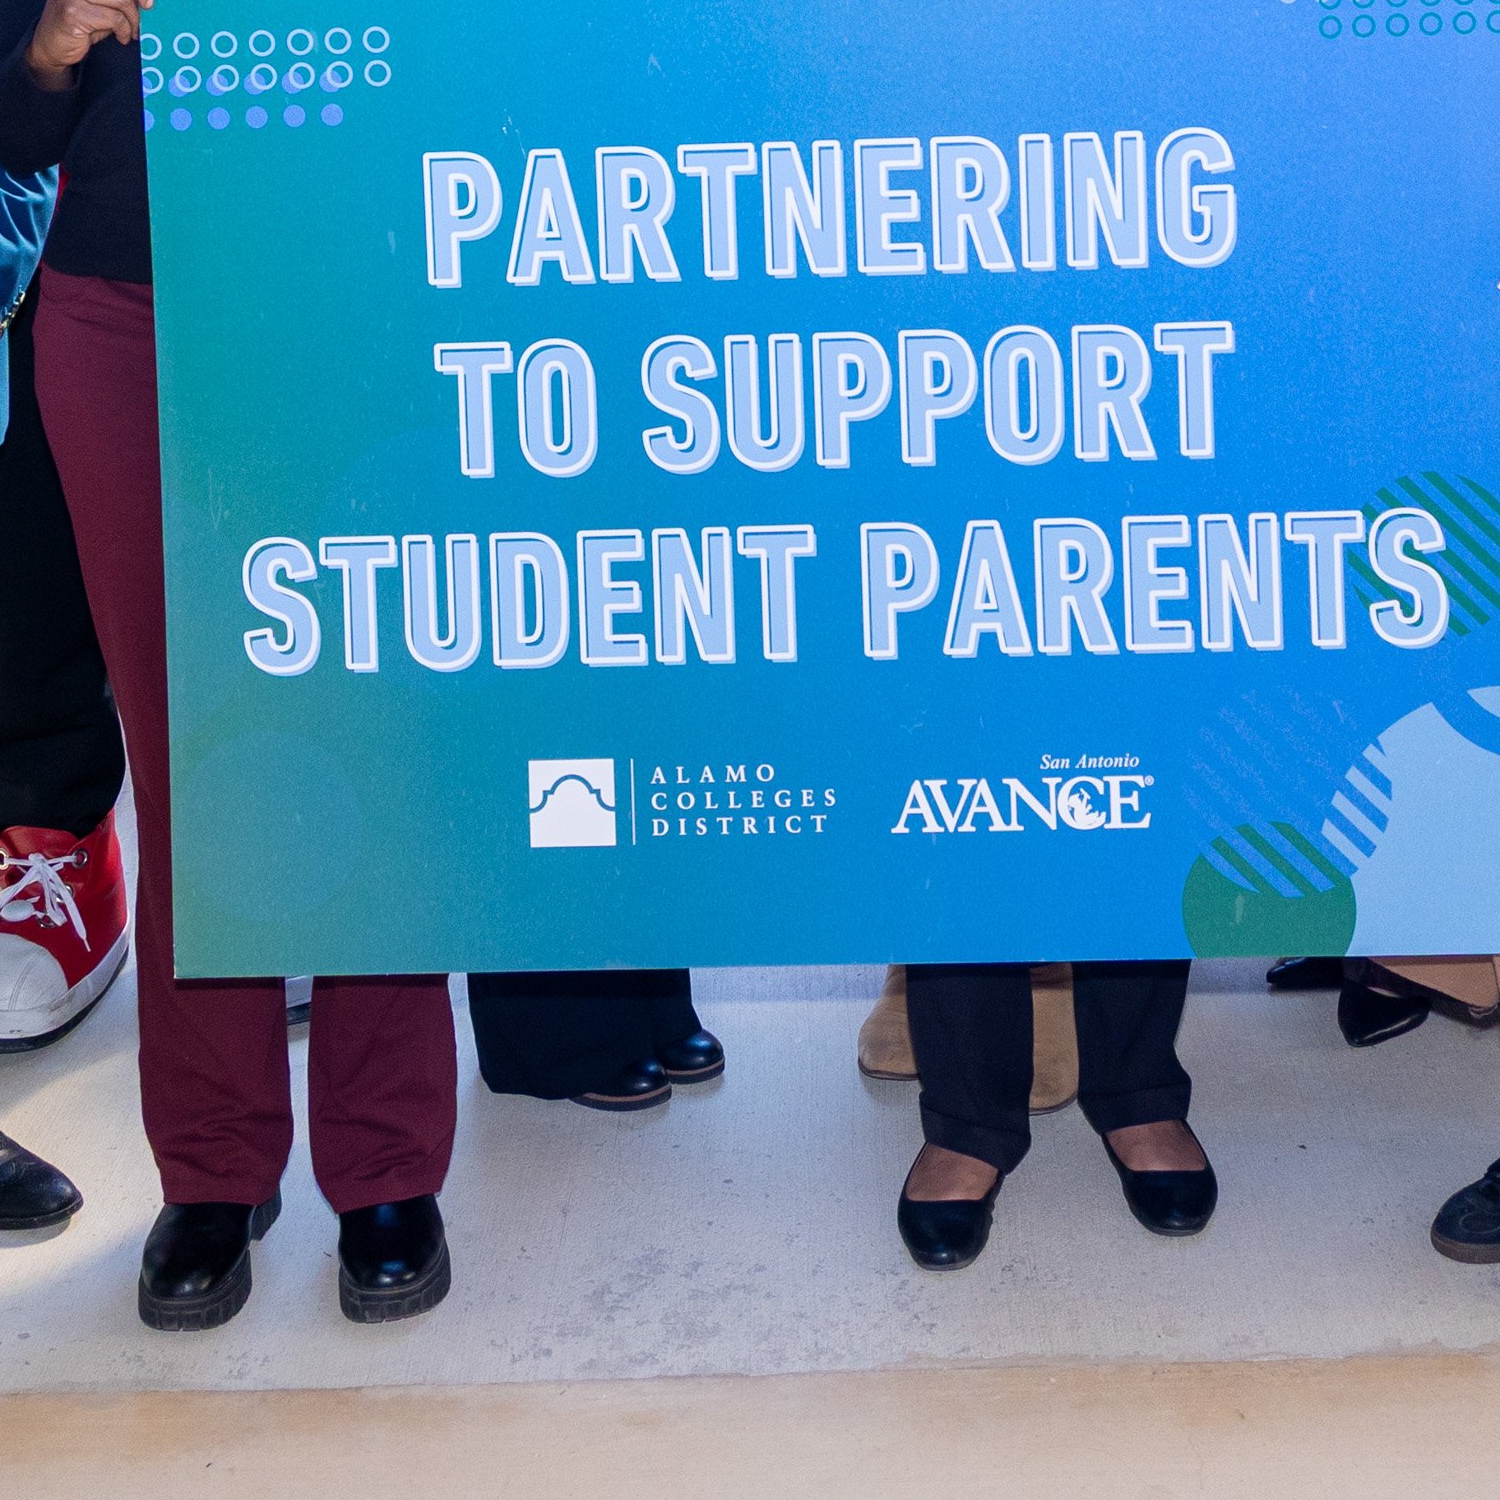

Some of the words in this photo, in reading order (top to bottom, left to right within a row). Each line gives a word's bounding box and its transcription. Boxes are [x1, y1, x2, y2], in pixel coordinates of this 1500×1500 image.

[422, 127, 1238, 288] PARTNERING
[433, 338, 599, 478] TO
[641, 321, 1236, 474] SUPPORT
[242, 524, 816, 675] STUDENT
[860, 507, 1451, 661] PARENTS
[1039, 753, 1070, 770] San
[1075, 752, 1140, 769] Antonio
[650, 763, 775, 785] ALAMO
[650, 788, 837, 811] COLLEGES
[651, 814, 828, 837] DISTRICT
